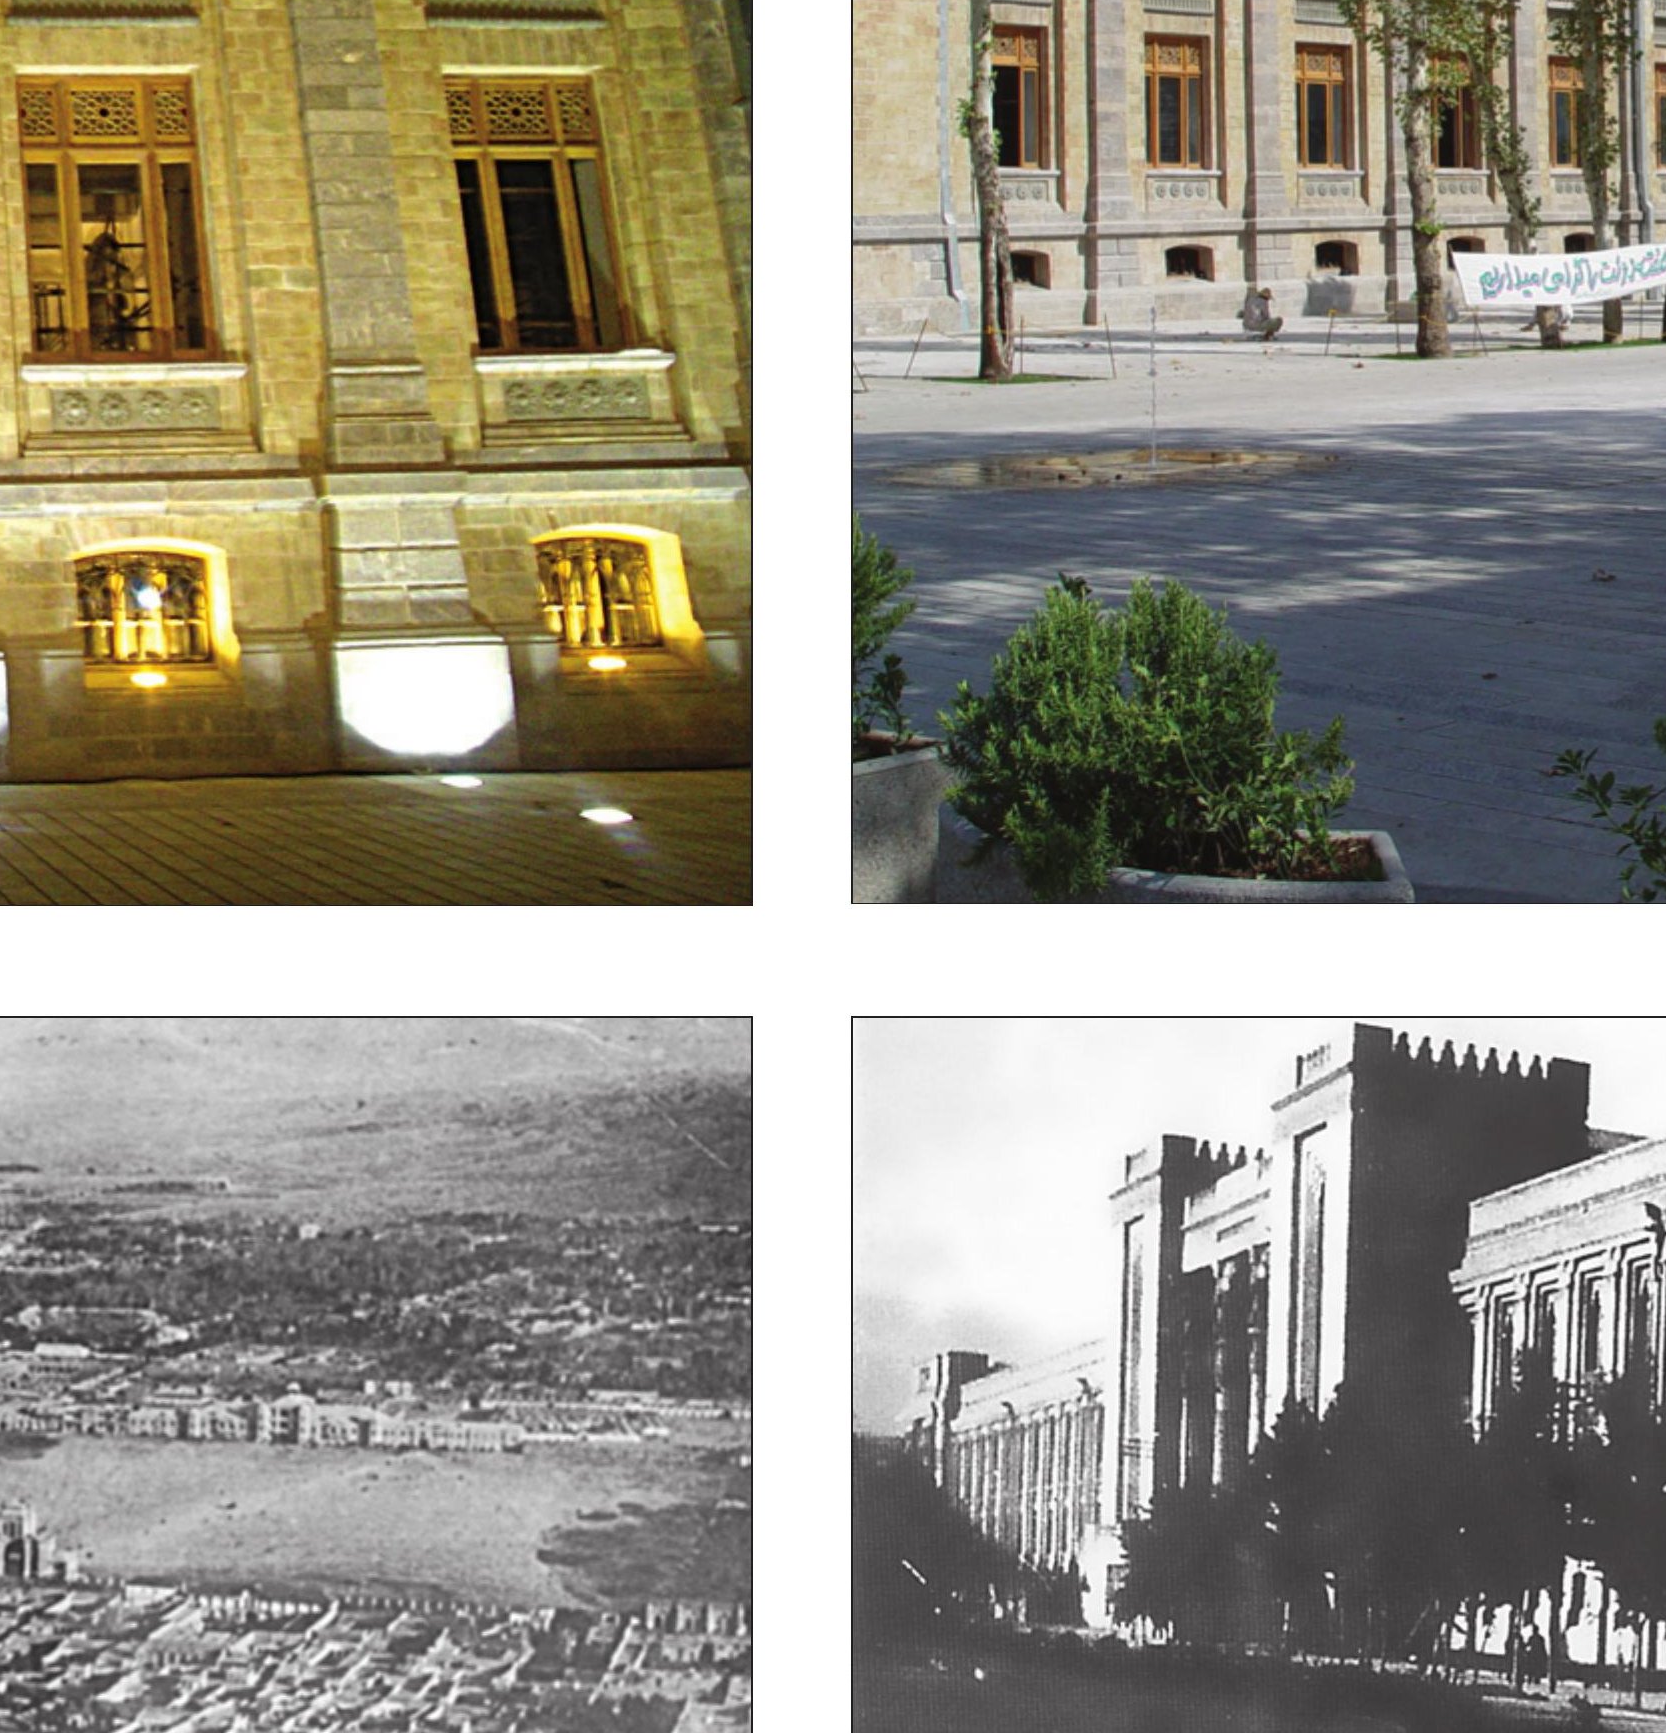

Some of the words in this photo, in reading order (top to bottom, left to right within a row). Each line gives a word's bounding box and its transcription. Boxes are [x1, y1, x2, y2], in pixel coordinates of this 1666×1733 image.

[1542, 258, 1584, 295] گرامی
[1583, 258, 1598, 291] را
[1600, 254, 1635, 287] دولت
